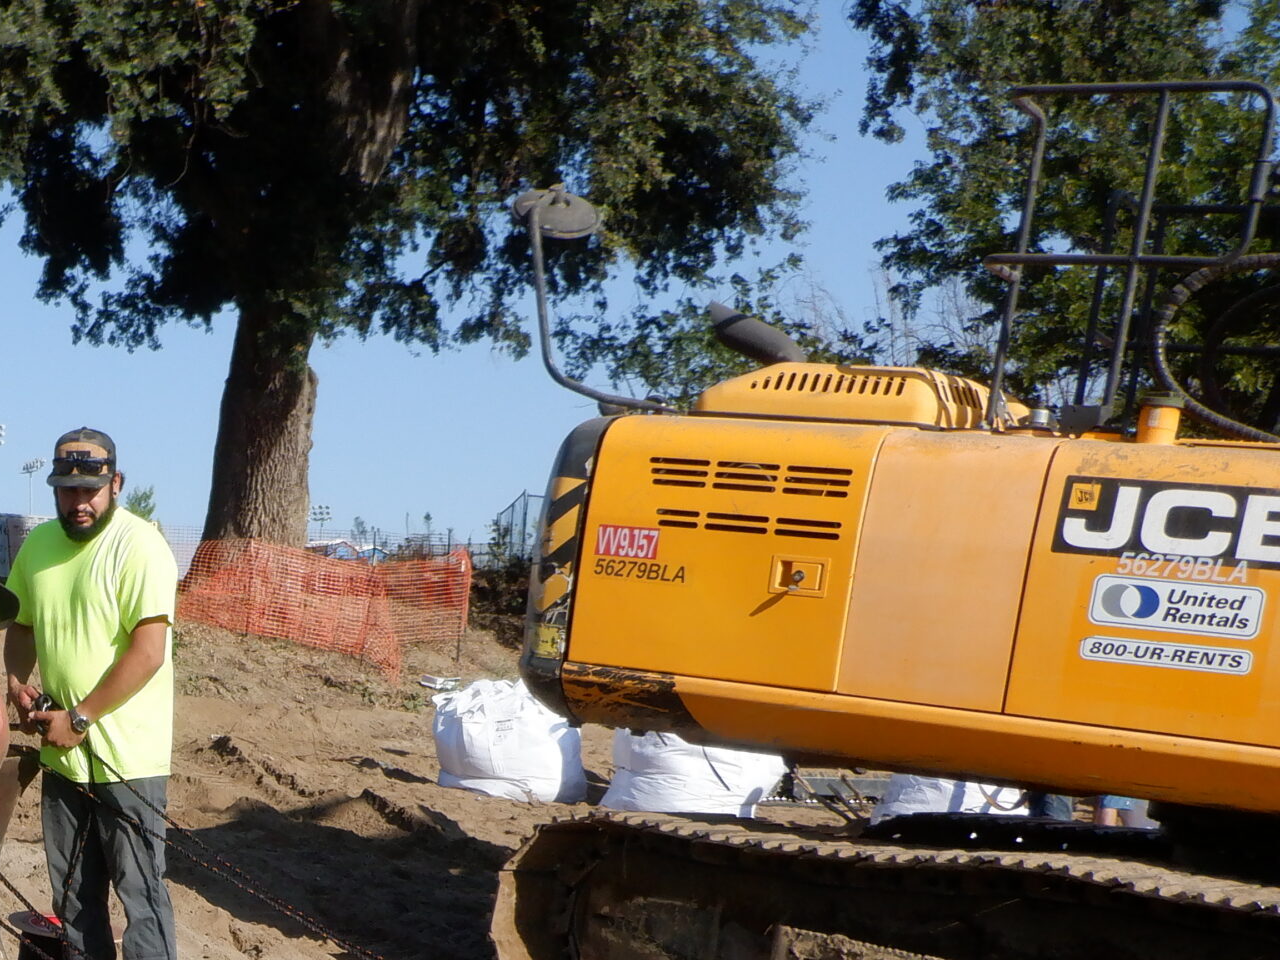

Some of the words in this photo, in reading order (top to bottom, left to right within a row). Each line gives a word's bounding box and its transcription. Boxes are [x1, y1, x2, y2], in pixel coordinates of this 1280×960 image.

[594, 558, 686, 583] 56279BLA
[1116, 552, 1248, 583] 56279BLA
[1166, 589, 1247, 611] United
[1162, 607, 1249, 630] Rentals
[1089, 641, 1244, 669] 800-UR-RENTS
